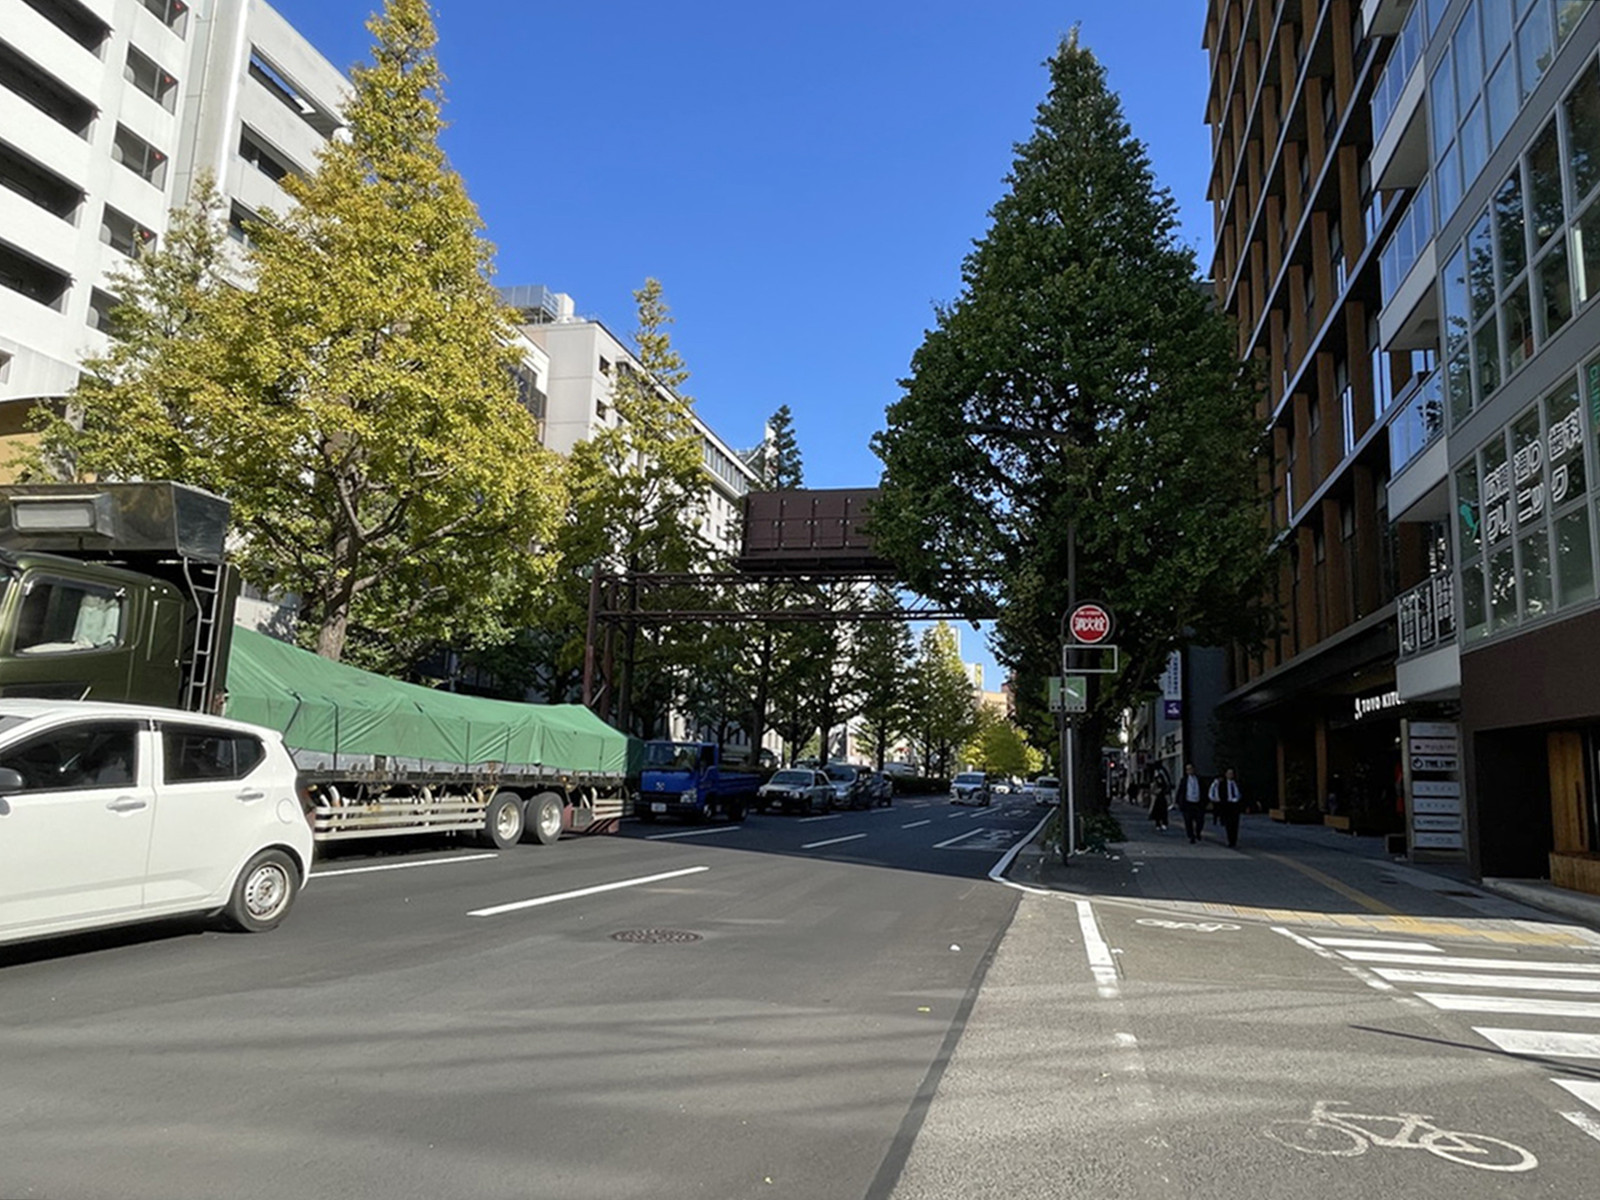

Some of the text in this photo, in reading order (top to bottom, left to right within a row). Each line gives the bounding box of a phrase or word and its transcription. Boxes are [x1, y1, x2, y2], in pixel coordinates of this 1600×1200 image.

[1487, 464, 1568, 541] クリニック
[1074, 616, 1105, 632] 消火栓
